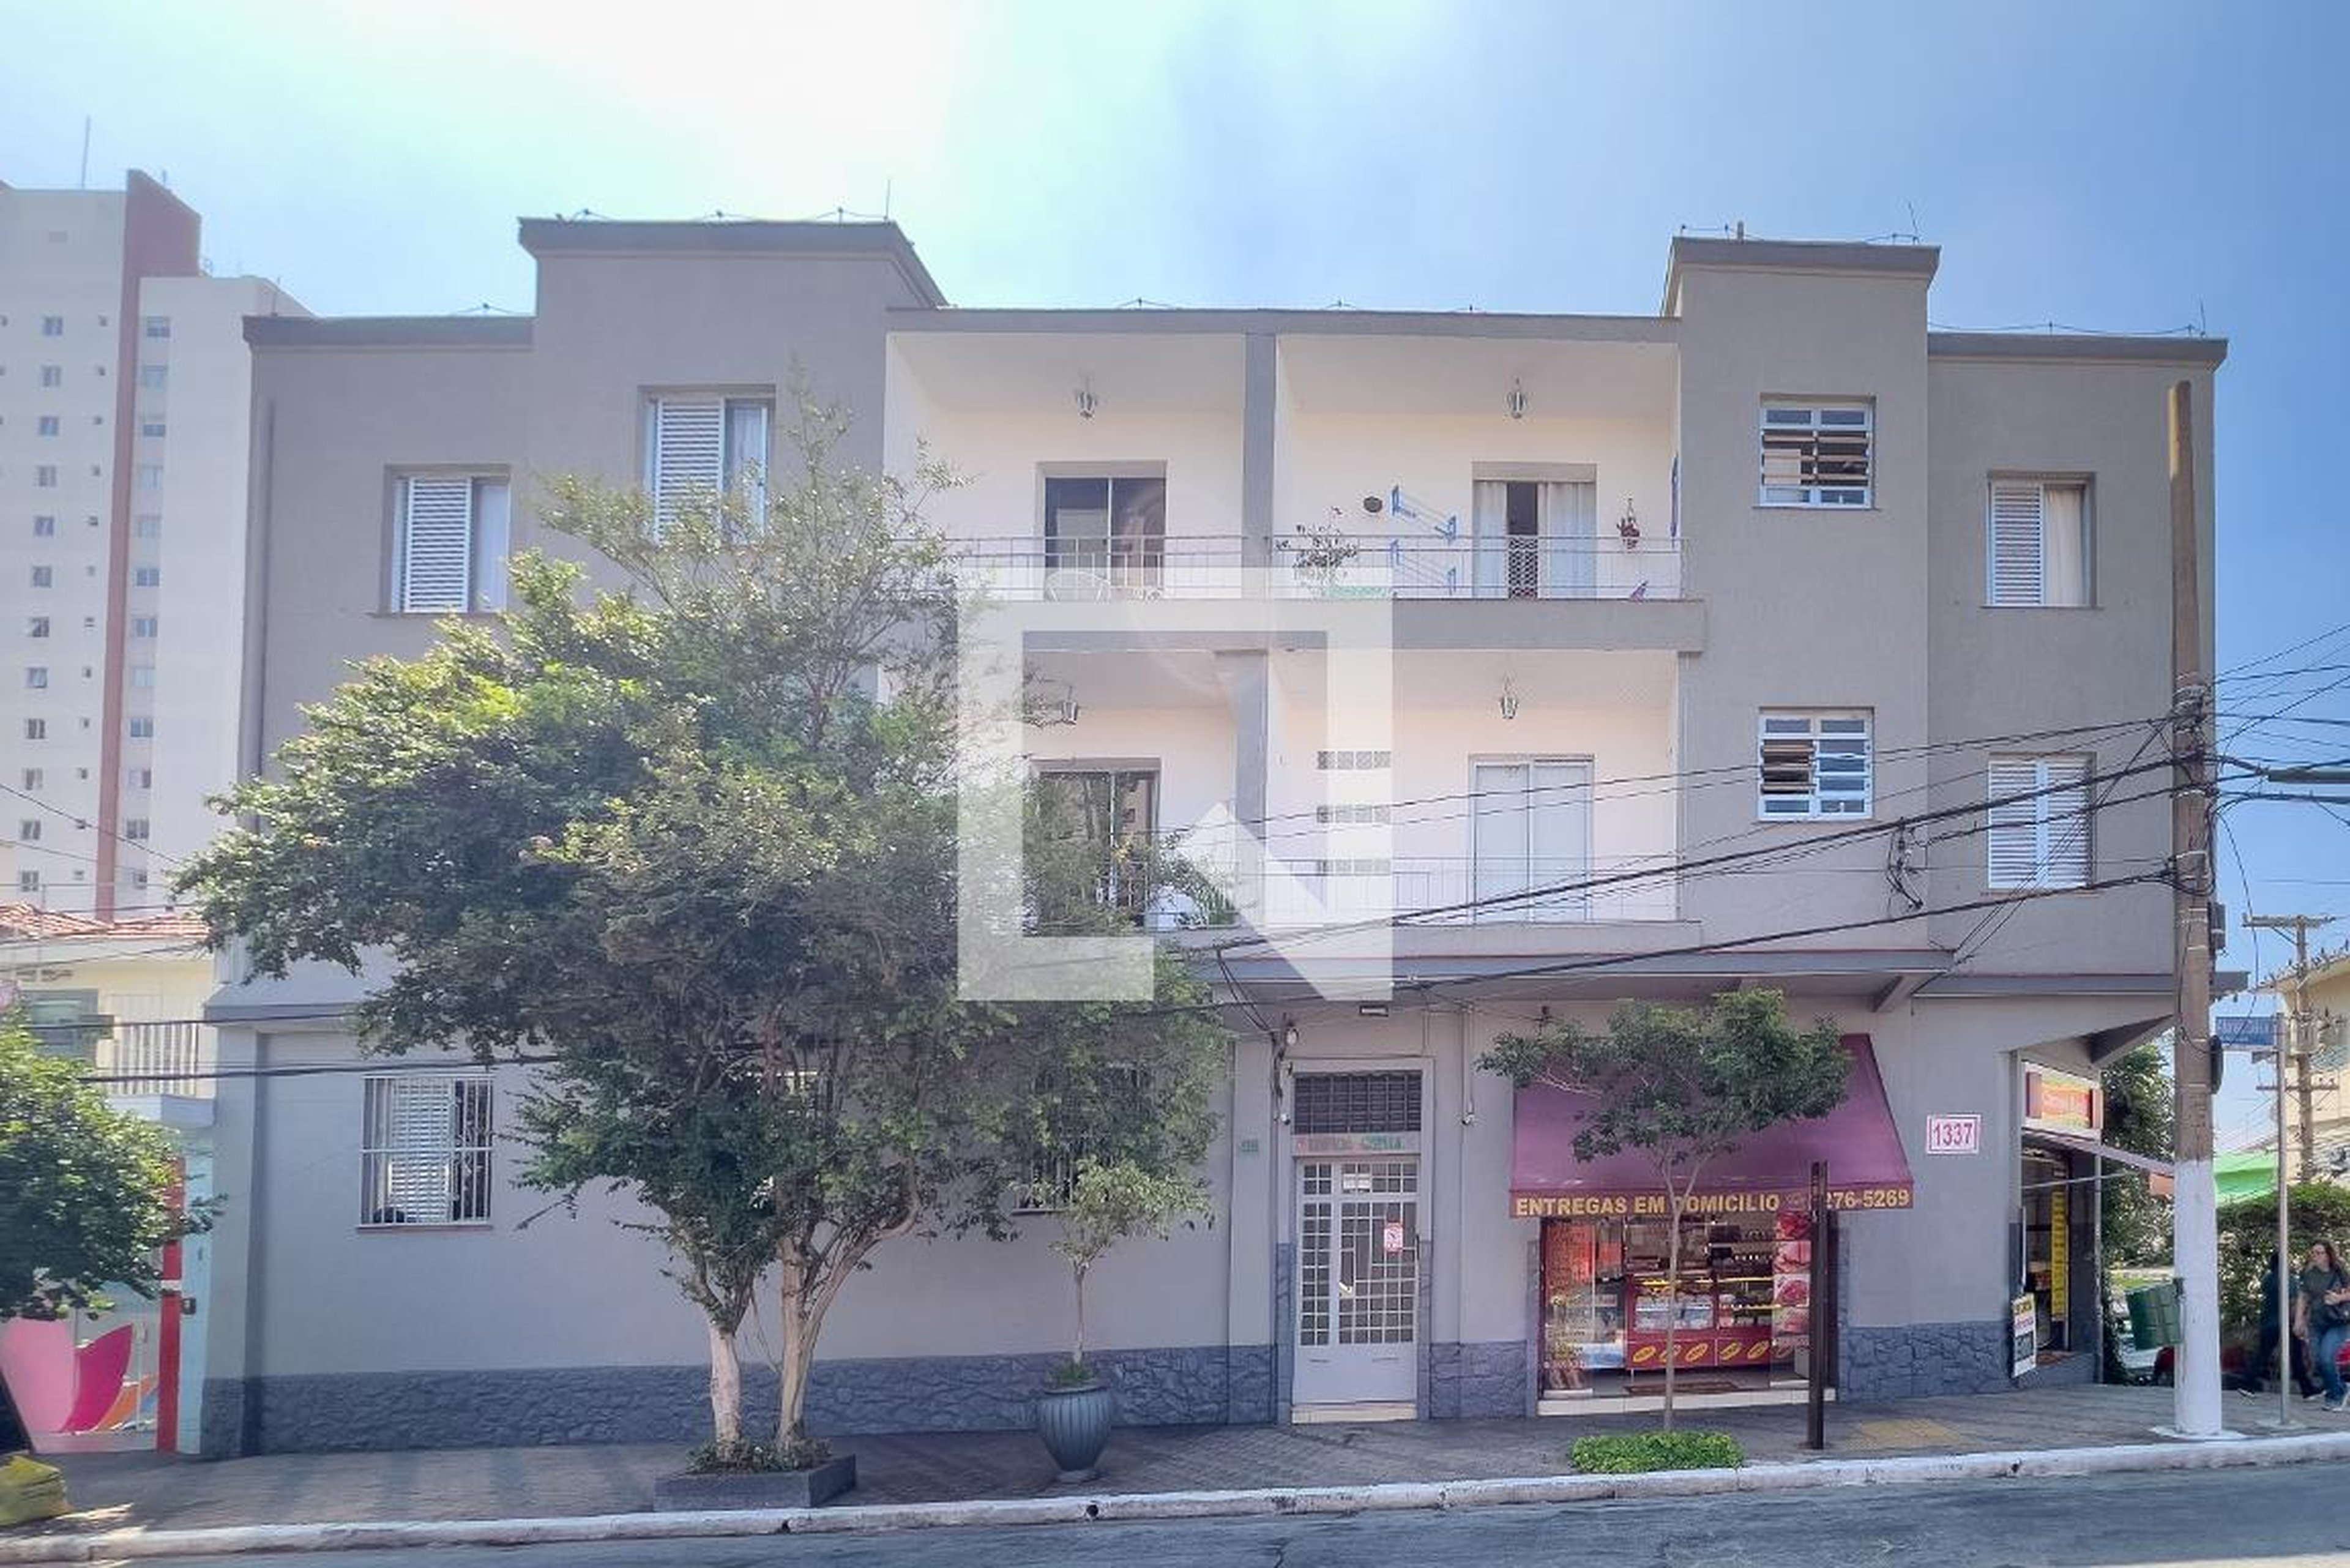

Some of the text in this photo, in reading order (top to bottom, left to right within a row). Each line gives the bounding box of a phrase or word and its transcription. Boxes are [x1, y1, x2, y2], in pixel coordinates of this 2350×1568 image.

[1934, 1122, 1972, 1146] 1337
[1516, 1196, 1627, 1215] ENTREGAS
[1634, 1196, 1665, 1214] EM
